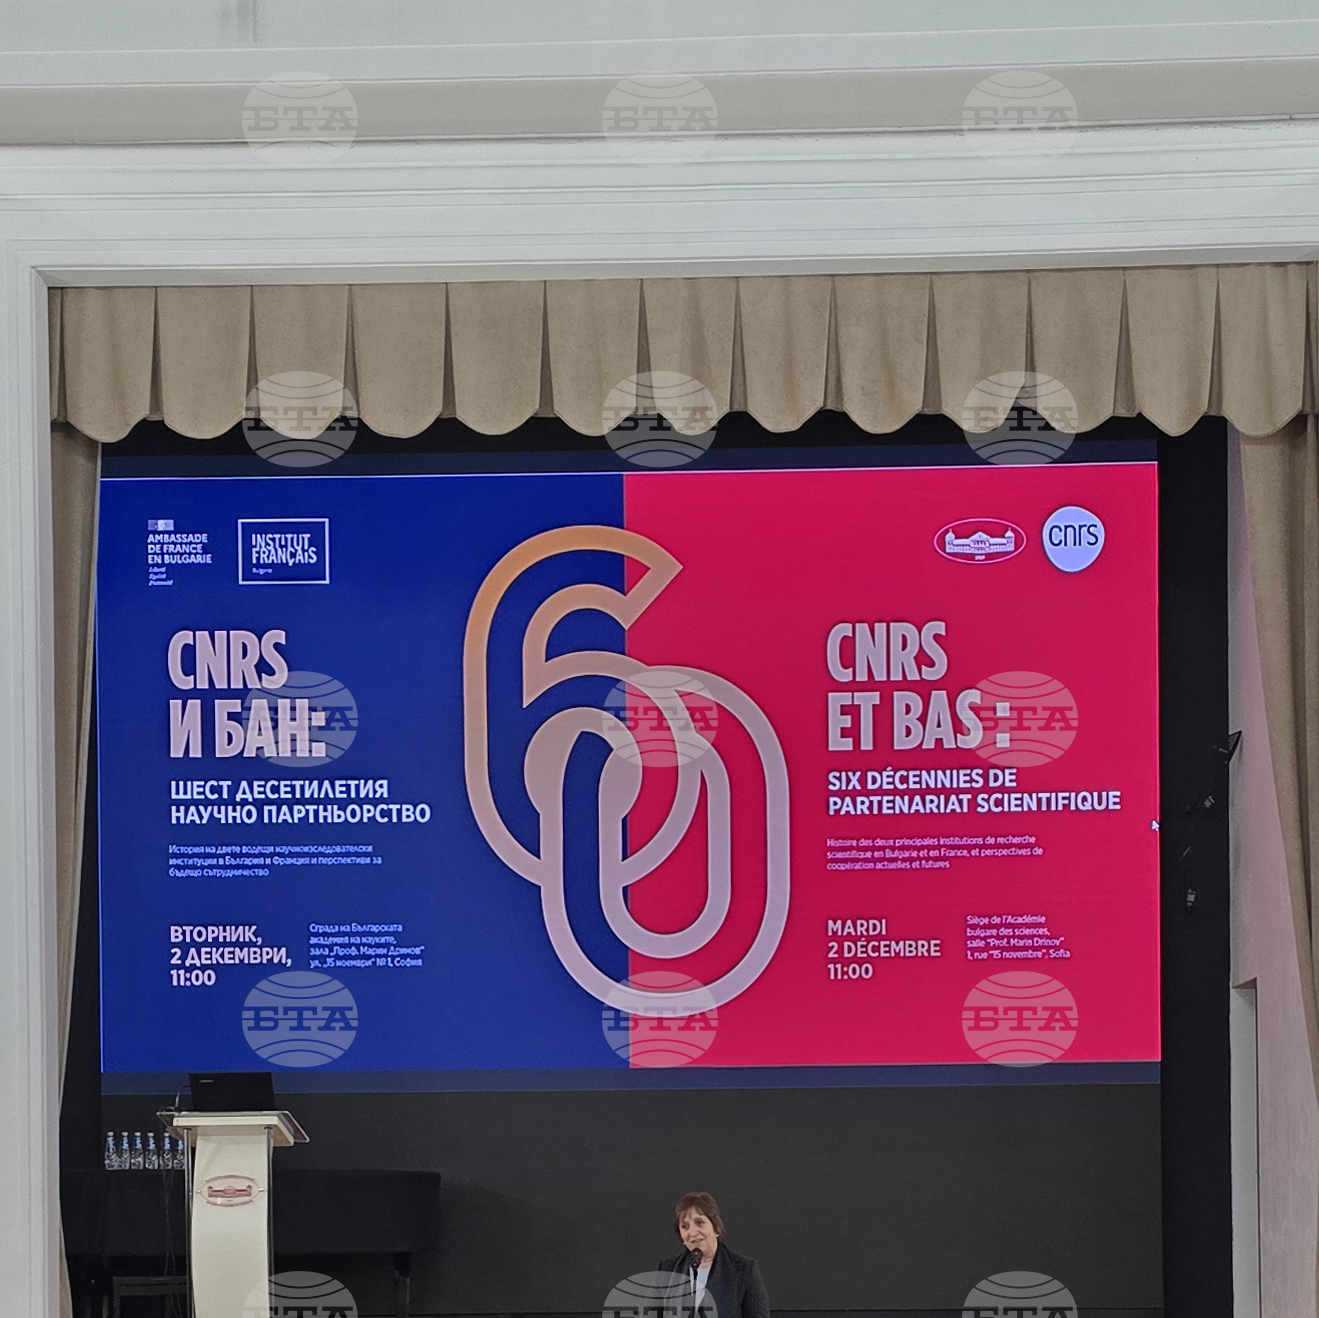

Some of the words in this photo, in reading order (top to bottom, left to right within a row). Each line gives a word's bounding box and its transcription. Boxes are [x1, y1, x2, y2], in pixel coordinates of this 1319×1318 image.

[147, 534, 207, 543] AMBASSADE
[252, 534, 310, 551] INSTITUT
[1048, 523, 1099, 547] cnrs
[148, 544, 161, 553] DE
[163, 544, 202, 553] FRANCE
[148, 555, 161, 564] EN
[164, 554, 212, 563] BULGARIE
[167, 629, 288, 690] CNRS
[826, 620, 948, 682] CNRS
[169, 699, 202, 758] И
[215, 699, 326, 758] БАН:
[827, 691, 880, 751] ET
[828, 771, 861, 791] SIX
[867, 766, 984, 790] DÉCENNIES
[988, 768, 1017, 787] DE
[171, 781, 231, 799] ШЕСТ
[236, 779, 388, 802] ДЕСЕТИЛЕТИЯ
[829, 794, 971, 815] PARTENARIAT
[976, 791, 1121, 813] SCIENTIFIQUE
[171, 805, 257, 824] НАУЧНО
[264, 804, 431, 823] ПАРТНЬОРСТВО
[895, 837, 938, 847] principales
[940, 837, 983, 845] institutions
[985, 836, 995, 844] de
[997, 836, 1035, 844] recherche
[981, 847, 1031, 858] perspectives
[170, 925, 262, 945] ВТОРНИК,
[827, 919, 886, 936] MARDI
[170, 948, 181, 964] 2
[185, 947, 292, 967] ДЕКЕМВРИ,
[827, 941, 838, 958] 2
[843, 938, 941, 957] DÉCEMBRE
[1049, 949, 1070, 958] Sofia
[171, 969, 216, 986] 11:00
[827, 963, 873, 980] 11:00
